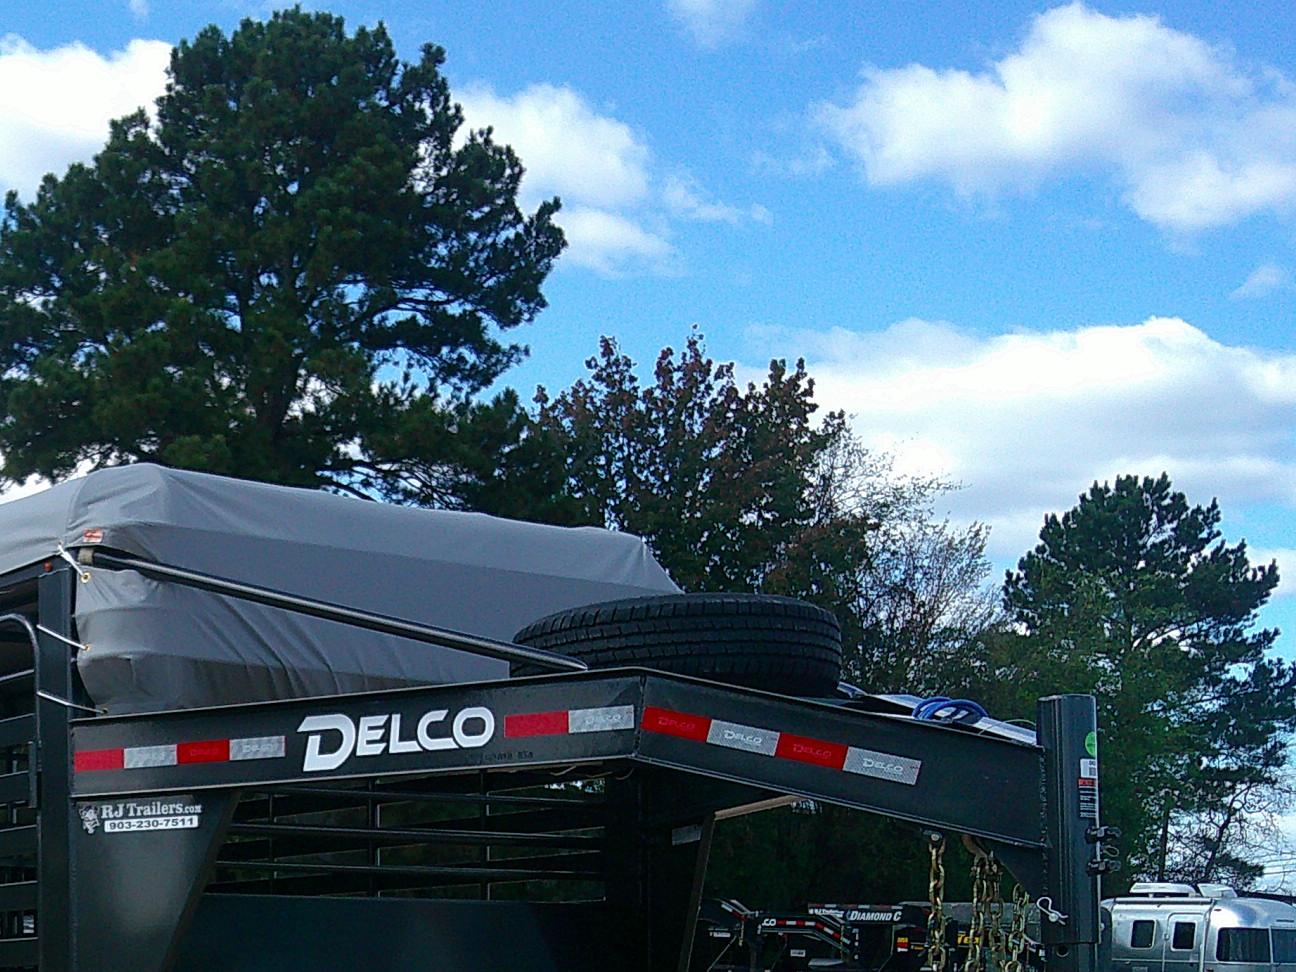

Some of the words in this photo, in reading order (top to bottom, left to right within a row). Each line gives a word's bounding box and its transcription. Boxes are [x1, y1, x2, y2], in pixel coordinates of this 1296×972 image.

[297, 707, 495, 772] DELCO
[723, 729, 762, 745] DELCO
[793, 743, 833, 758] DELCO
[862, 757, 904, 773] DELCO
[101, 804, 124, 818] RJ
[126, 801, 202, 817] Trailers.com
[109, 817, 194, 830] 903-230-7511
[850, 911, 892, 921] DIAMOND
[893, 911, 903, 921] C
